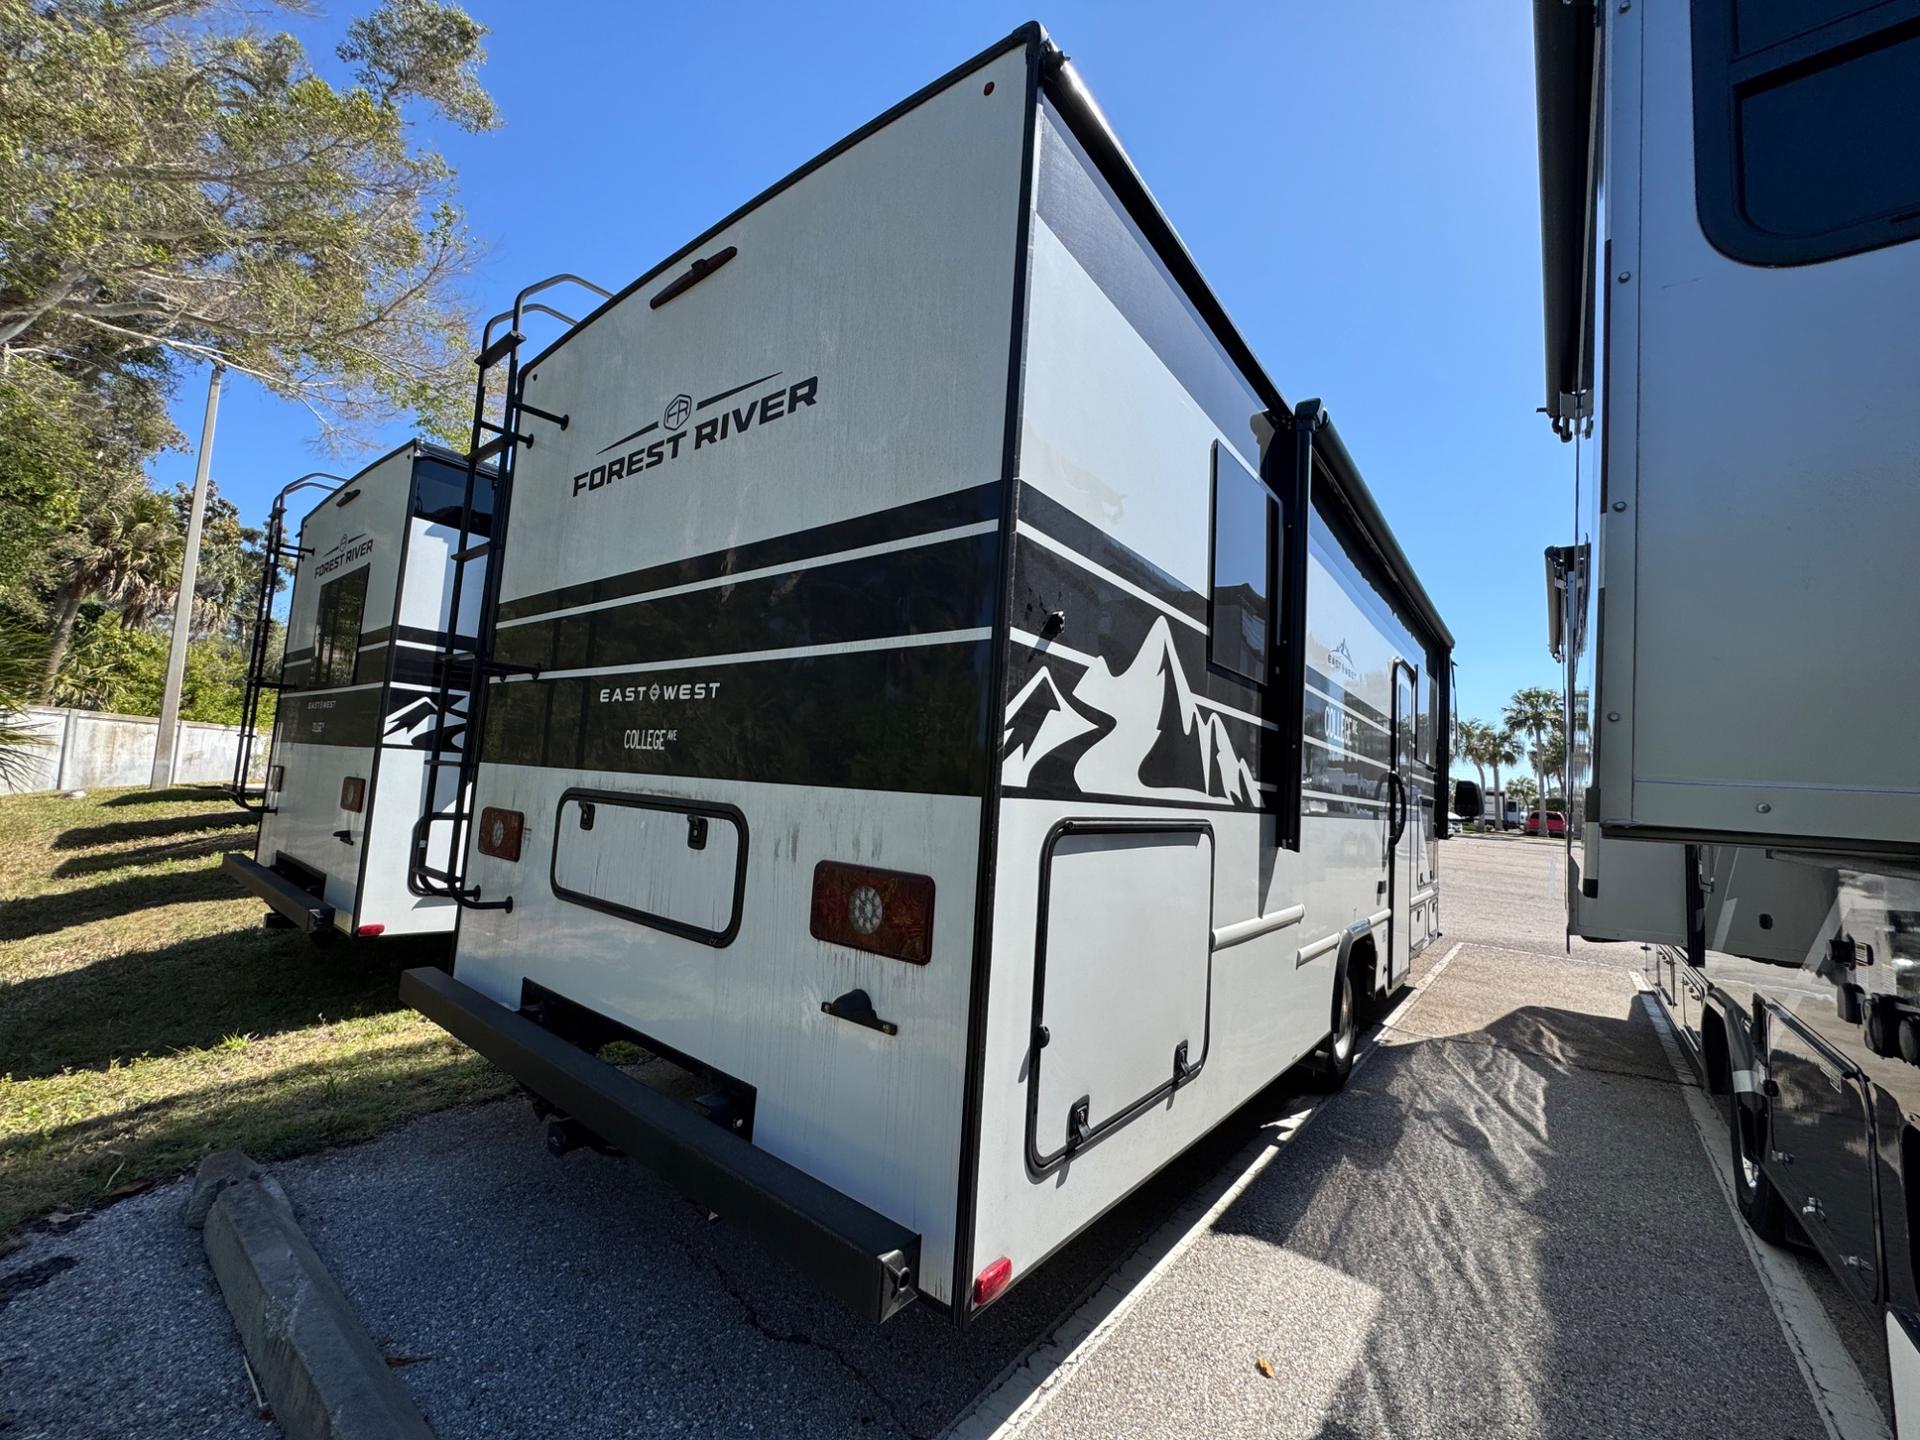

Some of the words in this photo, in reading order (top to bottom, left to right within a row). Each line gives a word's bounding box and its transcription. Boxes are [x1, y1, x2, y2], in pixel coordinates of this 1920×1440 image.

[573, 430, 687, 497] FOREST
[694, 375, 818, 450] RIVER
[314, 553, 345, 579] FOREST
[346, 538, 374, 563] RIVER
[600, 686, 647, 702] EAST
[663, 682, 720, 700] WEST
[624, 729, 667, 750] COLLEGE
